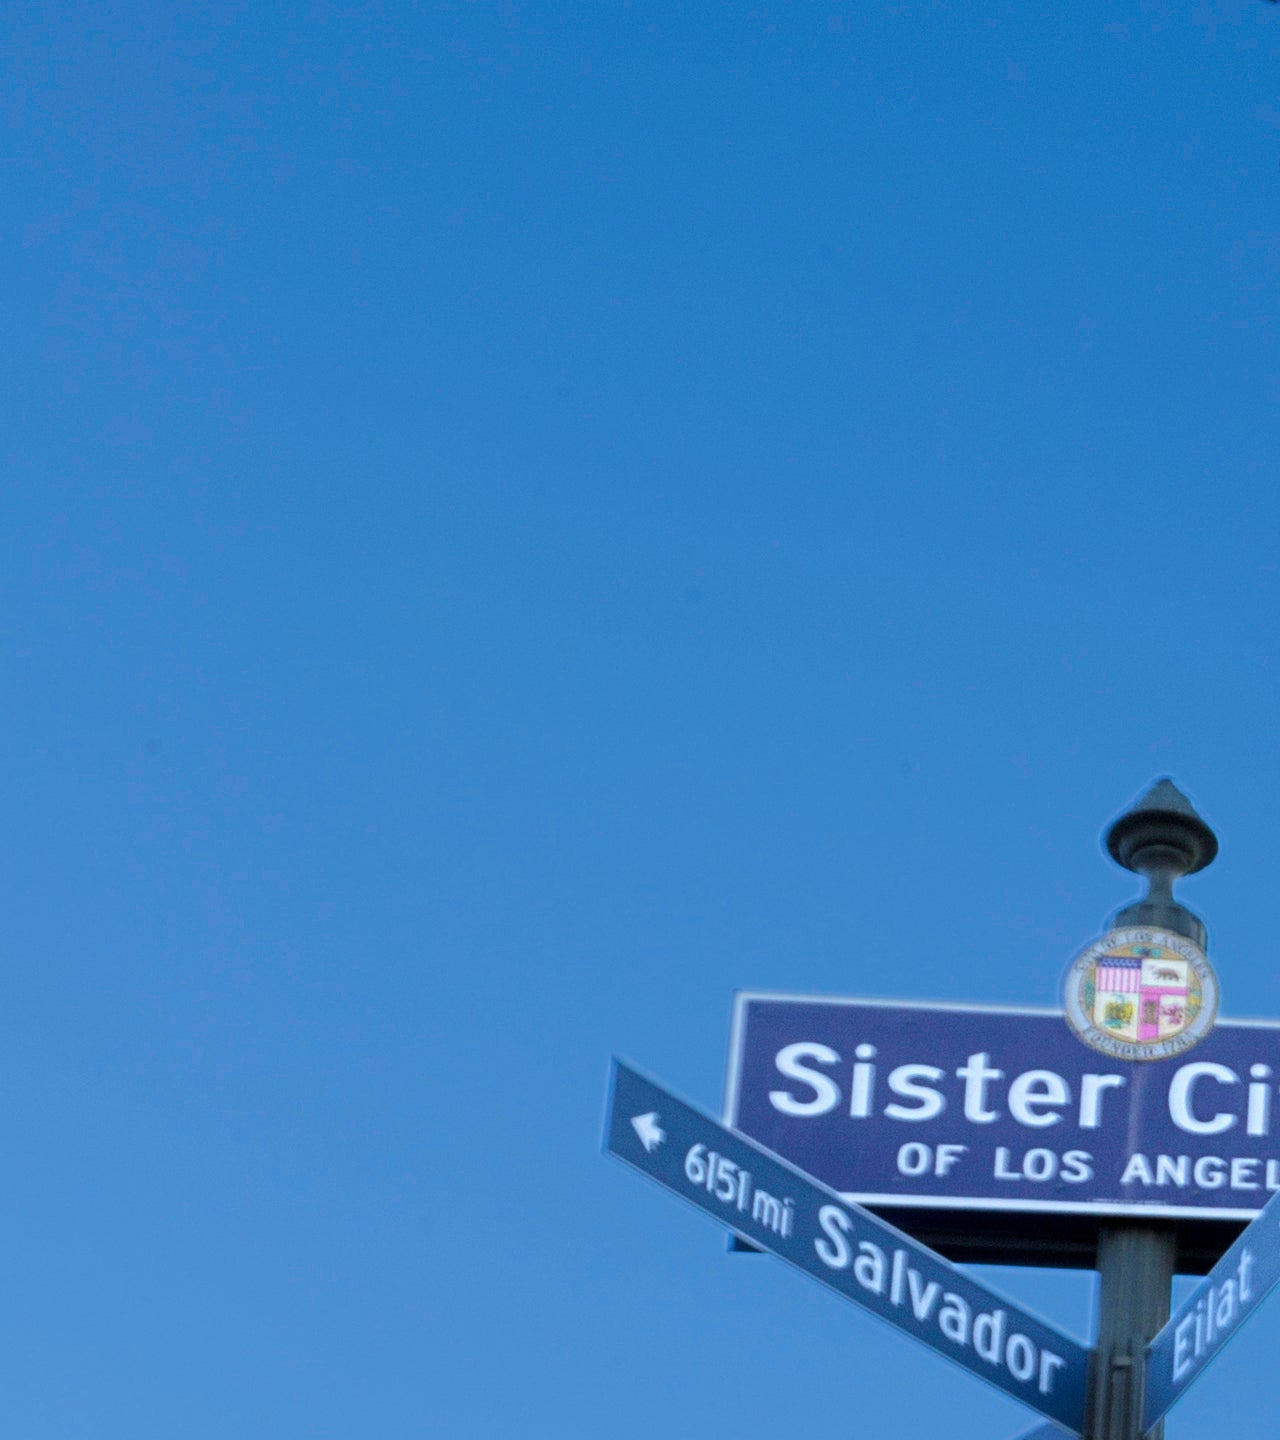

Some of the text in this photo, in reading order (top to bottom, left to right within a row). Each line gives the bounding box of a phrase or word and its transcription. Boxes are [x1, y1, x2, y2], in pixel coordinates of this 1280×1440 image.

[769, 1040, 1124, 1131] Sister
[896, 1140, 966, 1178] OF
[993, 1145, 1093, 1184] LOS
[684, 1143, 1063, 1395] 6151 mi Salvador
[1170, 1248, 1252, 1387] Eilat
